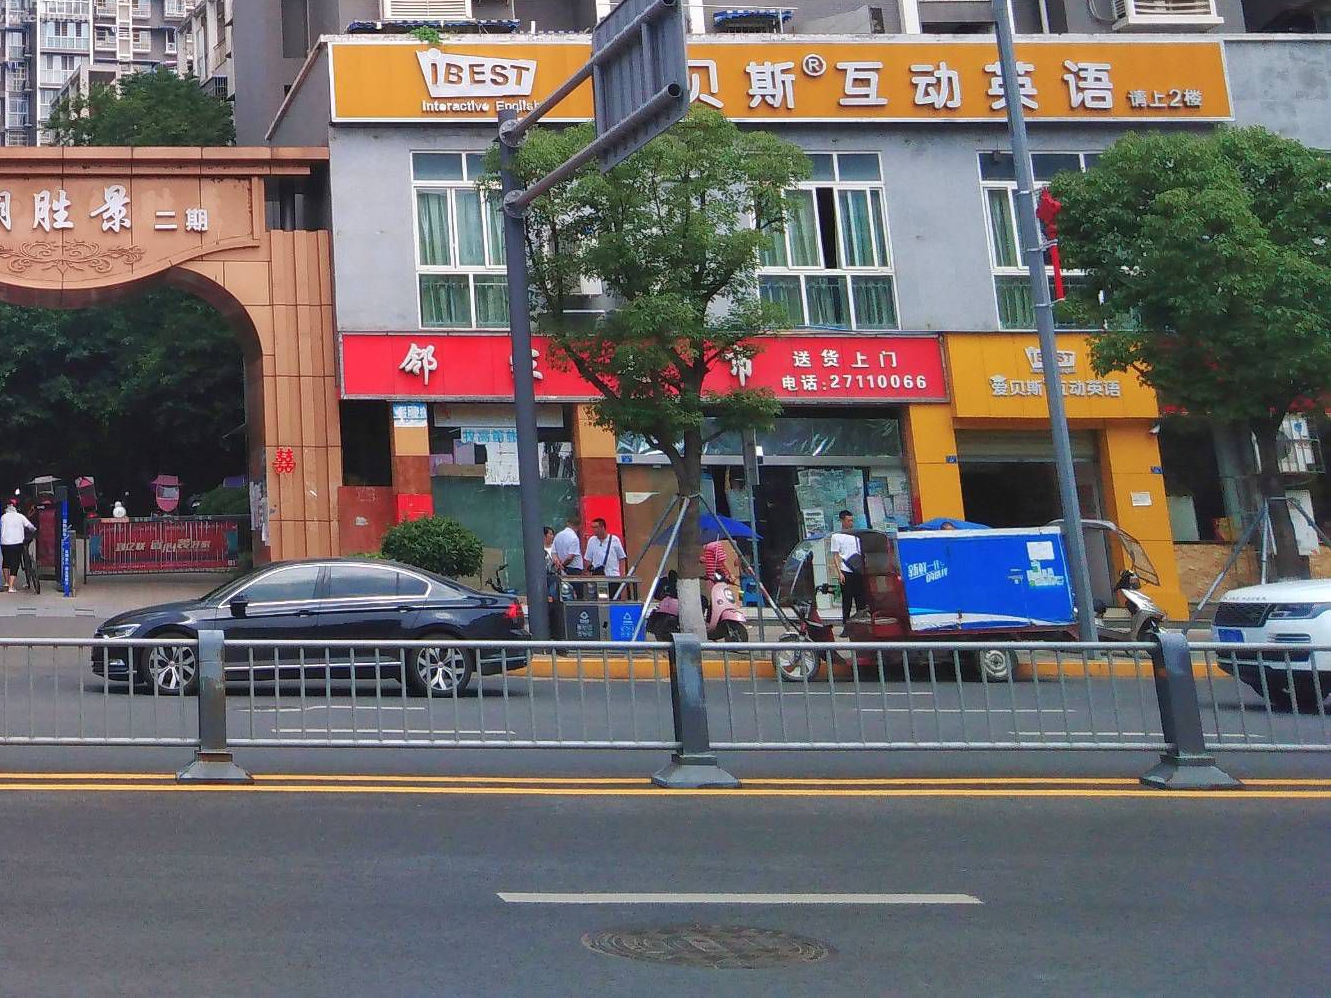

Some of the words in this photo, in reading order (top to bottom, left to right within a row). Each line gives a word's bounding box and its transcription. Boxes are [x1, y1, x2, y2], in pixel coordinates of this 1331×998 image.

[422, 100, 490, 113] Interactive
[1128, 88, 1203, 108] 请上2楼
[154, 208, 209, 233] 二期
[792, 349, 898, 368] 送货上门
